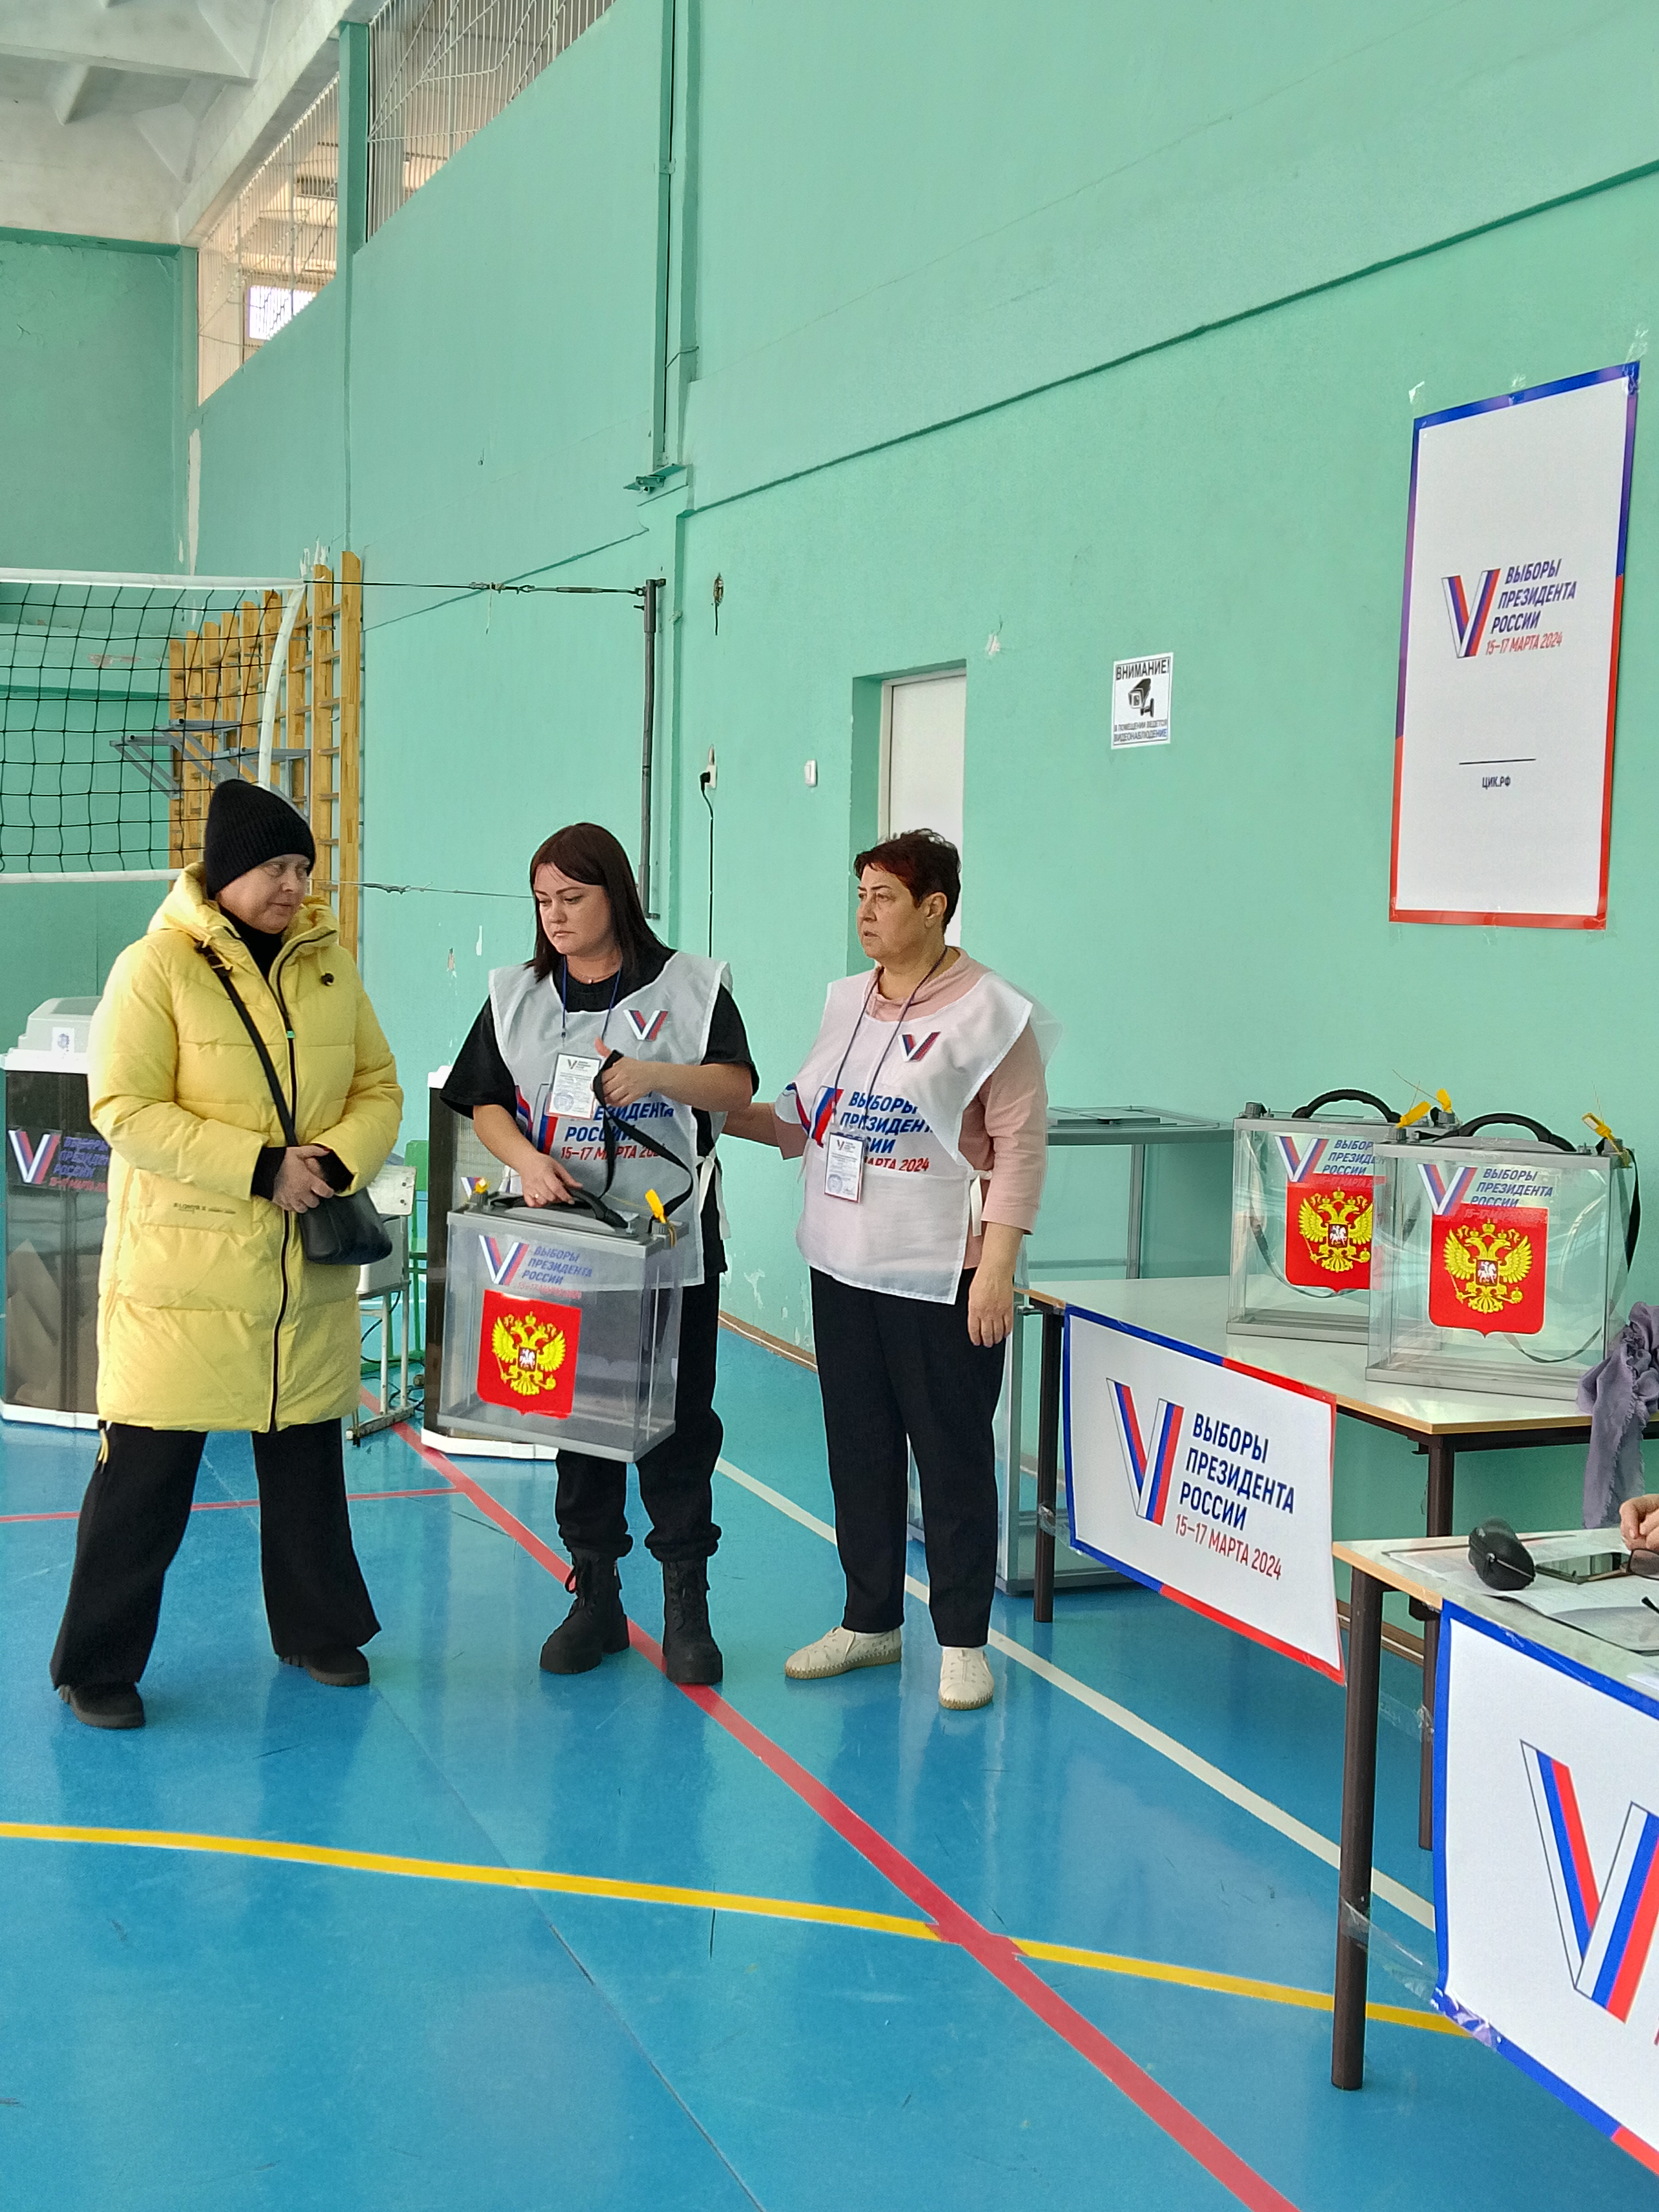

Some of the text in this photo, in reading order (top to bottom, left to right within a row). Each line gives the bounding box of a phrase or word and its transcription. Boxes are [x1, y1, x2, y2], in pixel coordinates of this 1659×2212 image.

[1505, 558, 1562, 585] ВЫБОРЫ
[1497, 581, 1577, 610] ПРЕЗИДЕНТА
[1490, 610, 1542, 635] РОССИИ
[1509, 634, 1540, 653] МАРТА
[1540, 631, 1562, 649] 2024
[1116, 658, 1170, 681] ВНИМАНИЕ!
[1482, 775, 1511, 790] ЦИК.РФ
[594, 1102, 675, 1121] ЕЗИДЕНТА
[839, 1111, 933, 1136] ПРЕЗИДЕН
[594, 1145, 637, 1161] МРТА
[1334, 1139, 1374, 1150] ВЫБОР
[864, 1156, 896, 1170] АРТА
[898, 1157, 930, 1172] 2024
[1322, 1164, 1367, 1176] РОССИИ
[1482, 1168, 1539, 1182] ВЫБОРЫ
[1476, 1182, 1554, 1197] ПРЕЗИДЕНТА
[1470, 1196, 1520, 1208] РОССИИ
[534, 1246, 580, 1263] ВЫБОРЫ
[521, 1270, 564, 1285] РОССИИ
[528, 1258, 593, 1278] ПРЕЗИДЕНТА
[1192, 1413, 1269, 1464] ВЫБОРЫ
[1185, 1447, 1294, 1514] ПРЕЗИДЕНТА
[1179, 1481, 1247, 1532] РОССИИ
[1208, 1528, 1249, 1566] МАРТА
[1251, 1548, 1282, 1581] 2024
